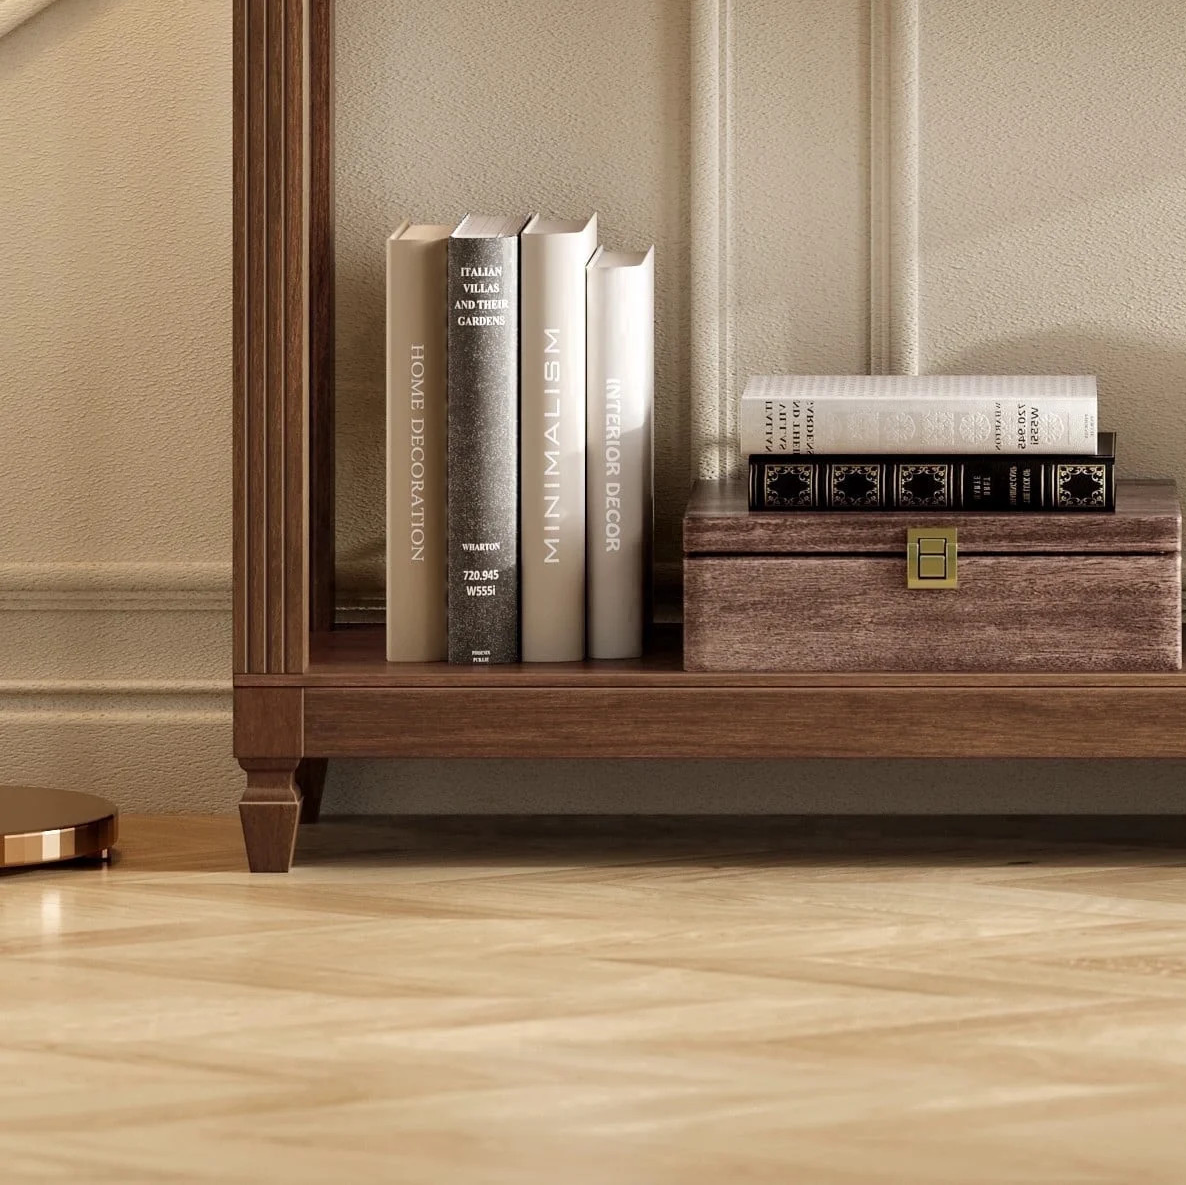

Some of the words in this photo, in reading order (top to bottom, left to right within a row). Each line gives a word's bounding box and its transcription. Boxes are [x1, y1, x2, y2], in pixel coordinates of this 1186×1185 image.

[460, 267, 502, 277] ITALIAN
[463, 283, 500, 293] VILLAS
[454, 300, 476, 310] AND
[476, 299, 509, 310] THEIR
[457, 316, 506, 326] GARDENS
[410, 344, 425, 409] HOME
[605, 378, 621, 477] INTERIOR
[544, 327, 561, 564] MINIMALISM
[410, 420, 425, 562] DECORATION
[605, 483, 621, 553] DECOR
[462, 542, 501, 552] WHARTON
[463, 569, 500, 581] 720.945
[466, 585, 496, 597] W555i
